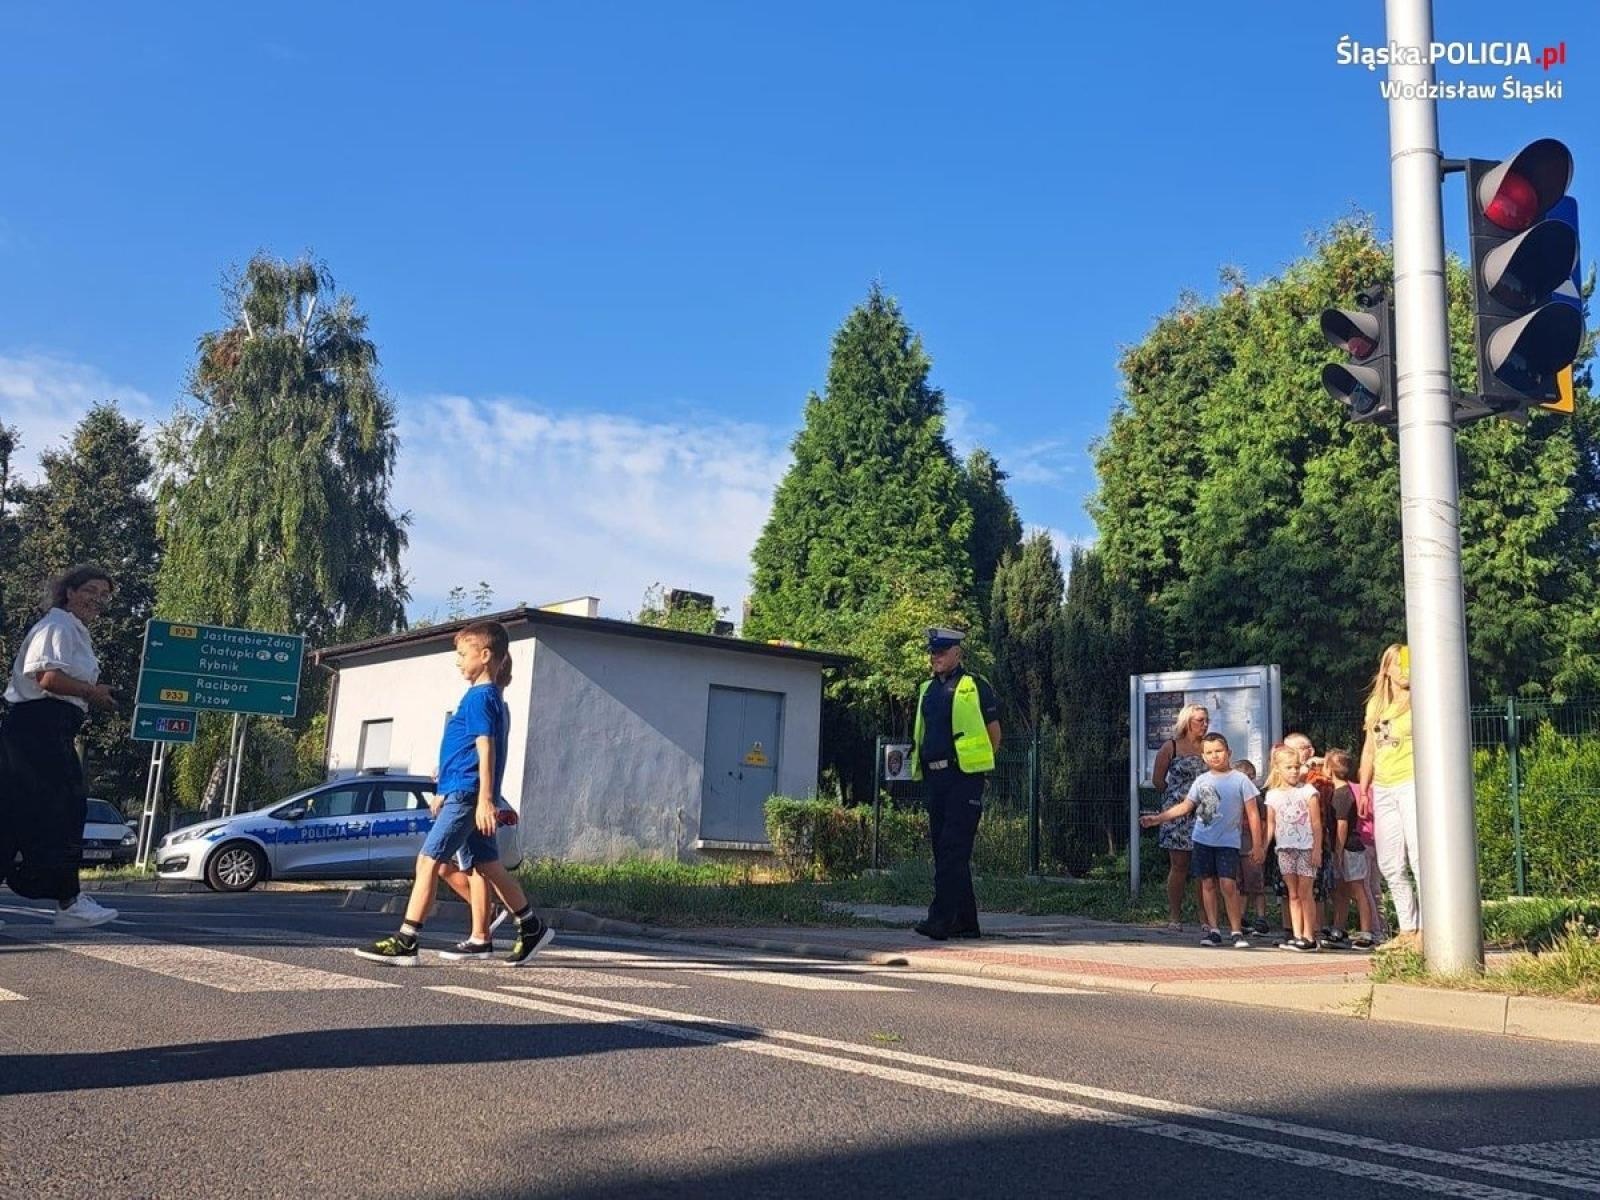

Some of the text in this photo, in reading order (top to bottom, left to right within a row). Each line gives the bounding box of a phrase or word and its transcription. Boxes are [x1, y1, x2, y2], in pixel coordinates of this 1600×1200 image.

[199, 657, 239, 672] Rybnik
[165, 691, 184, 700] 933
[301, 825, 347, 839] POLICJA
